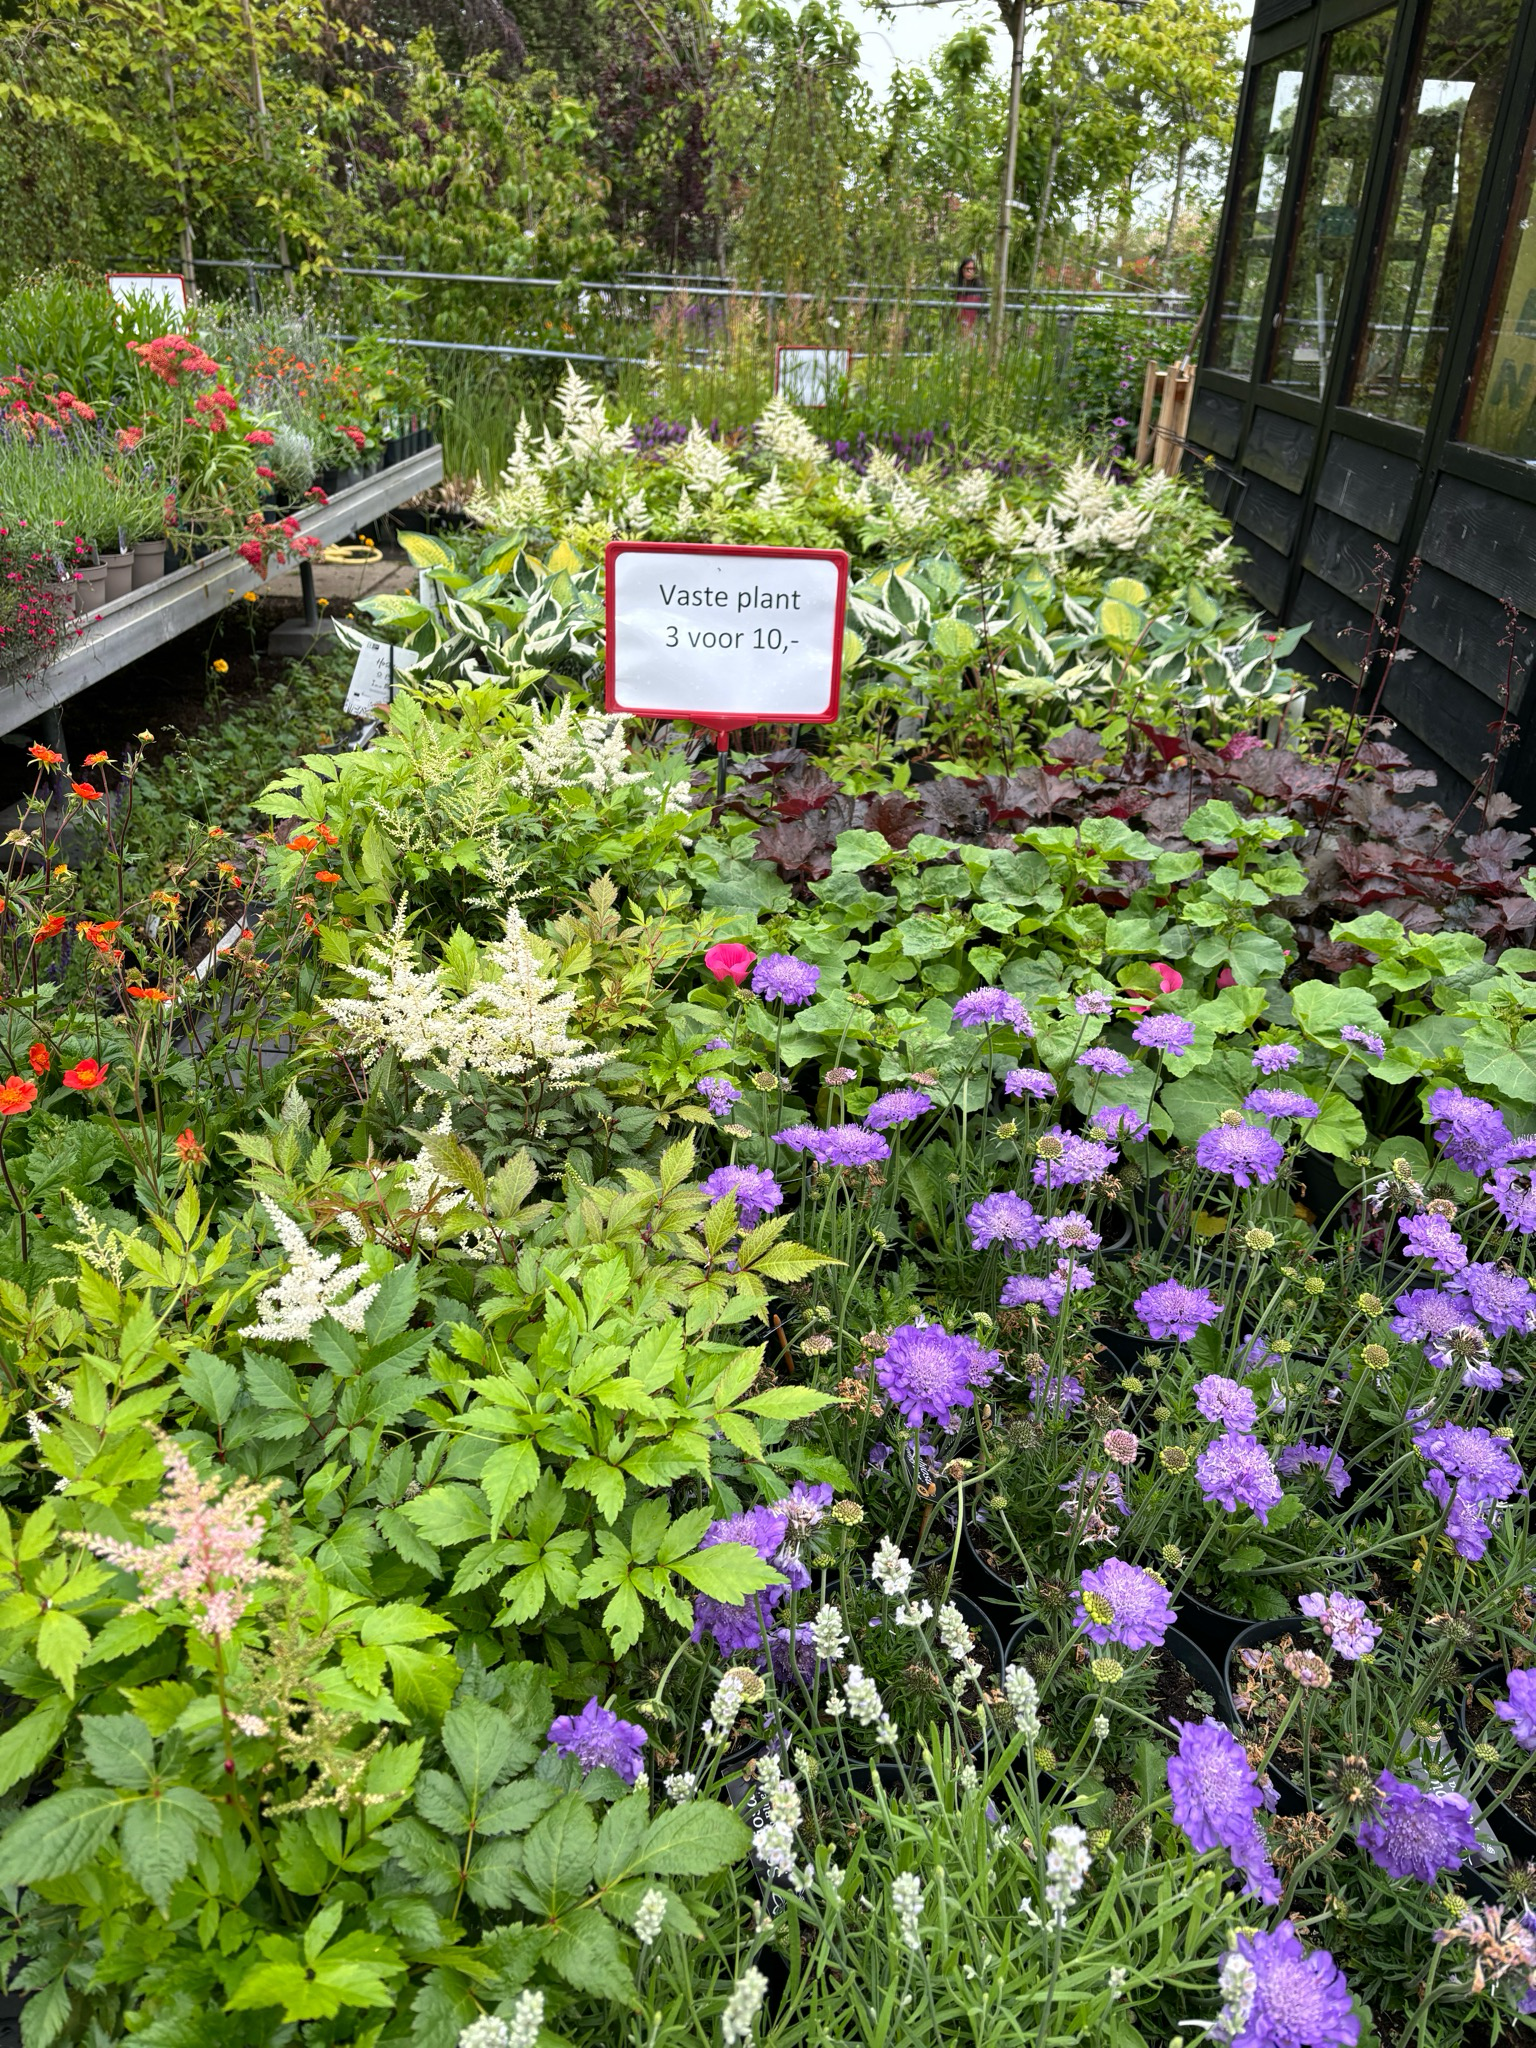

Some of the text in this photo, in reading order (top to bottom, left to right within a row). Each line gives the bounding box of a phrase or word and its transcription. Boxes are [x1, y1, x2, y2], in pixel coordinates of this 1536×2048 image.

[659, 584, 800, 613] Vaste plant
[665, 625, 798, 654] 3 voor 10,-
